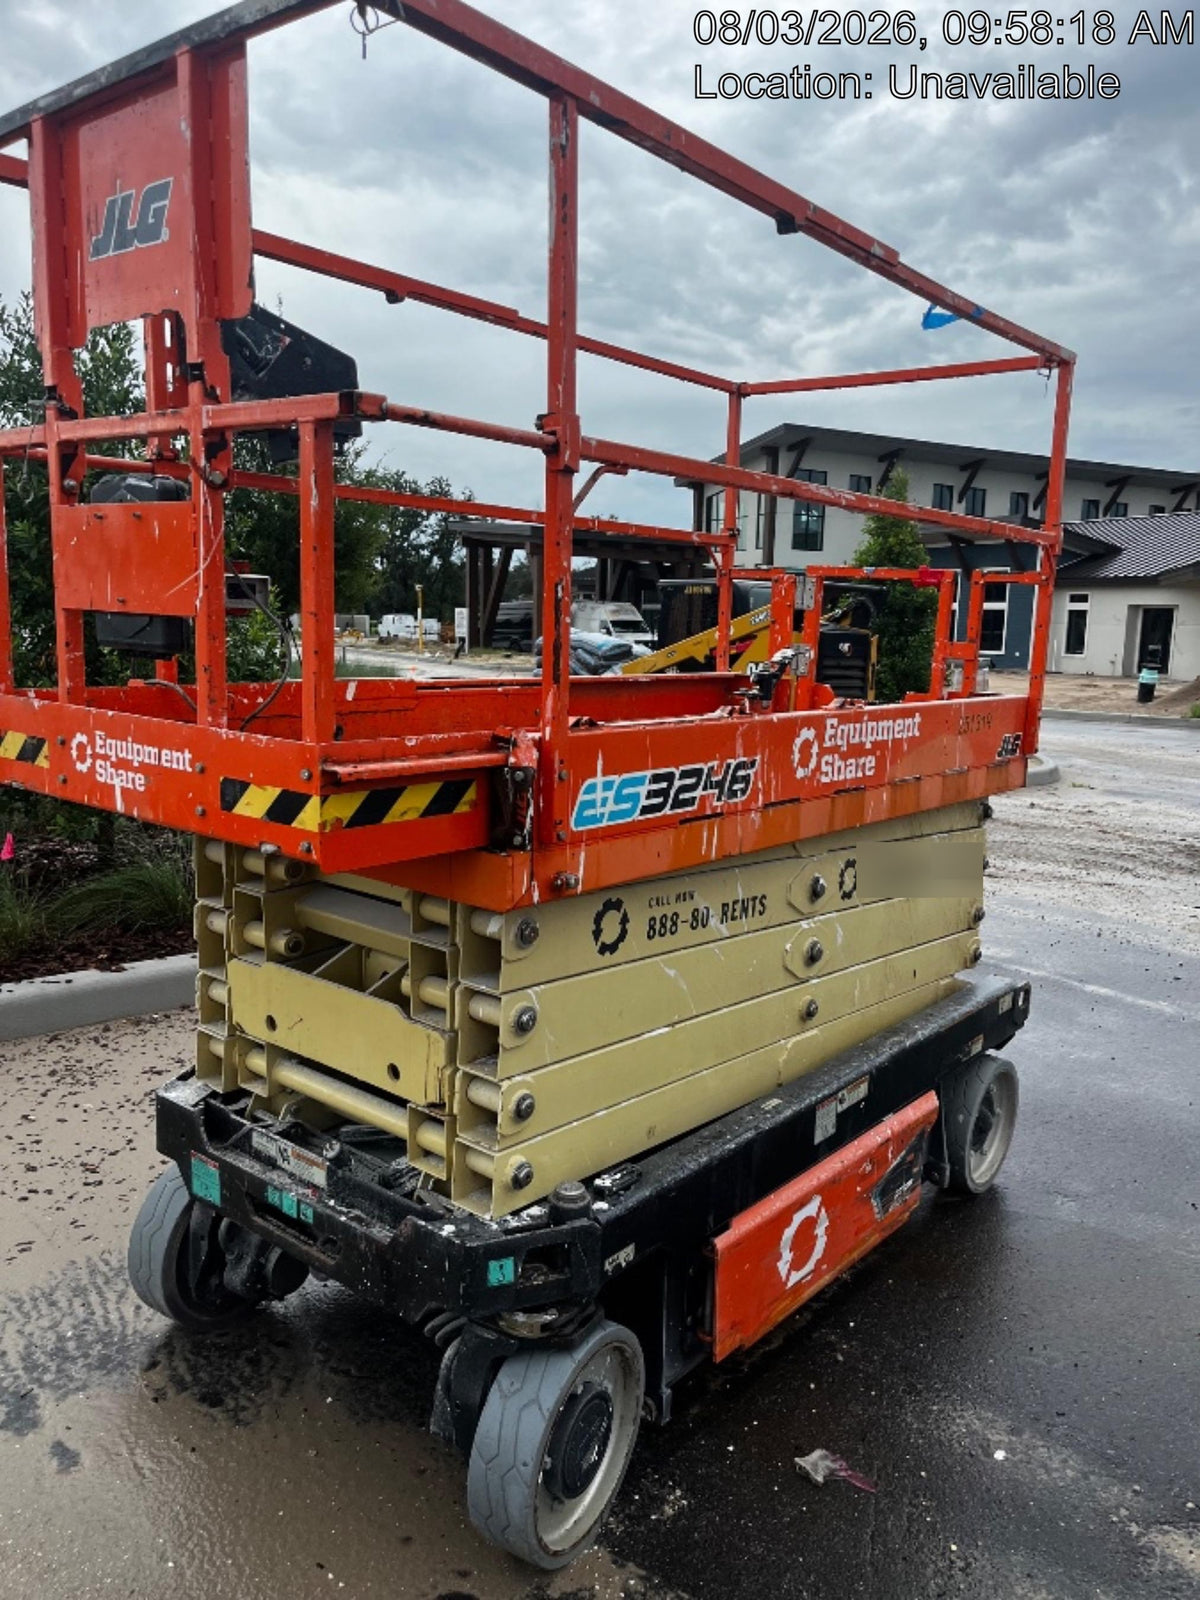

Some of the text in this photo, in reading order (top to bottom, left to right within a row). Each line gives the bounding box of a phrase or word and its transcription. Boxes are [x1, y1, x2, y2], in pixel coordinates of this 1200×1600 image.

[89, 177, 174, 262] JLG
[94, 730, 193, 773] Equipment
[823, 712, 922, 752] Equipment
[95, 759, 147, 792] Share
[820, 753, 876, 784] Share
[571, 754, 761, 832] ES3246
[648, 895, 672, 909] CALL
